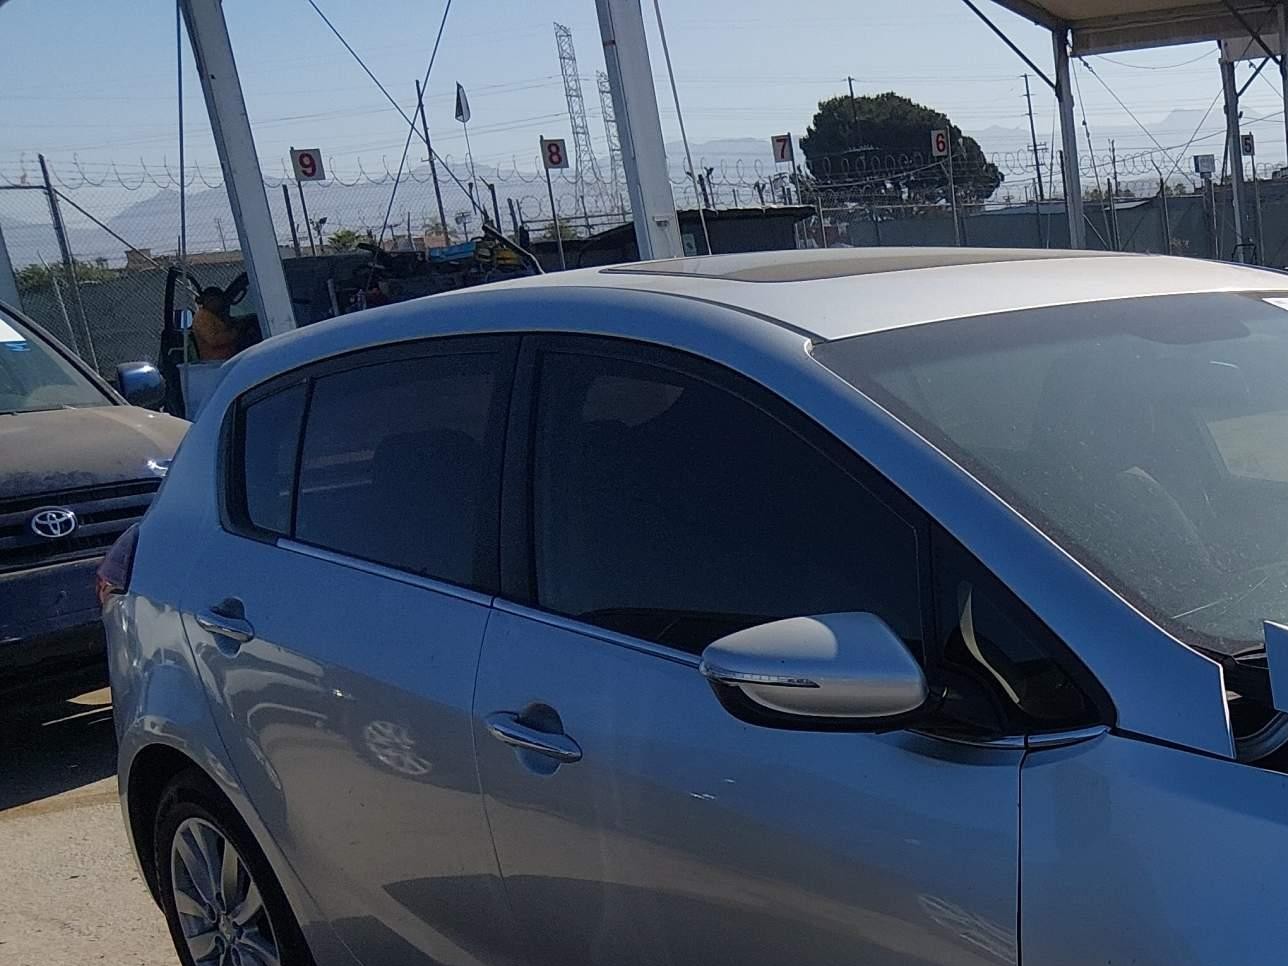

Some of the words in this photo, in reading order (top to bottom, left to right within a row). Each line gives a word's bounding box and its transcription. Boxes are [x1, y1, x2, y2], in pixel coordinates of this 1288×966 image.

[546, 142, 562, 166] 8
[775, 138, 789, 160] 7
[935, 133, 946, 153] 6
[1243, 137, 1252, 153] 5
[298, 152, 317, 177] 9
